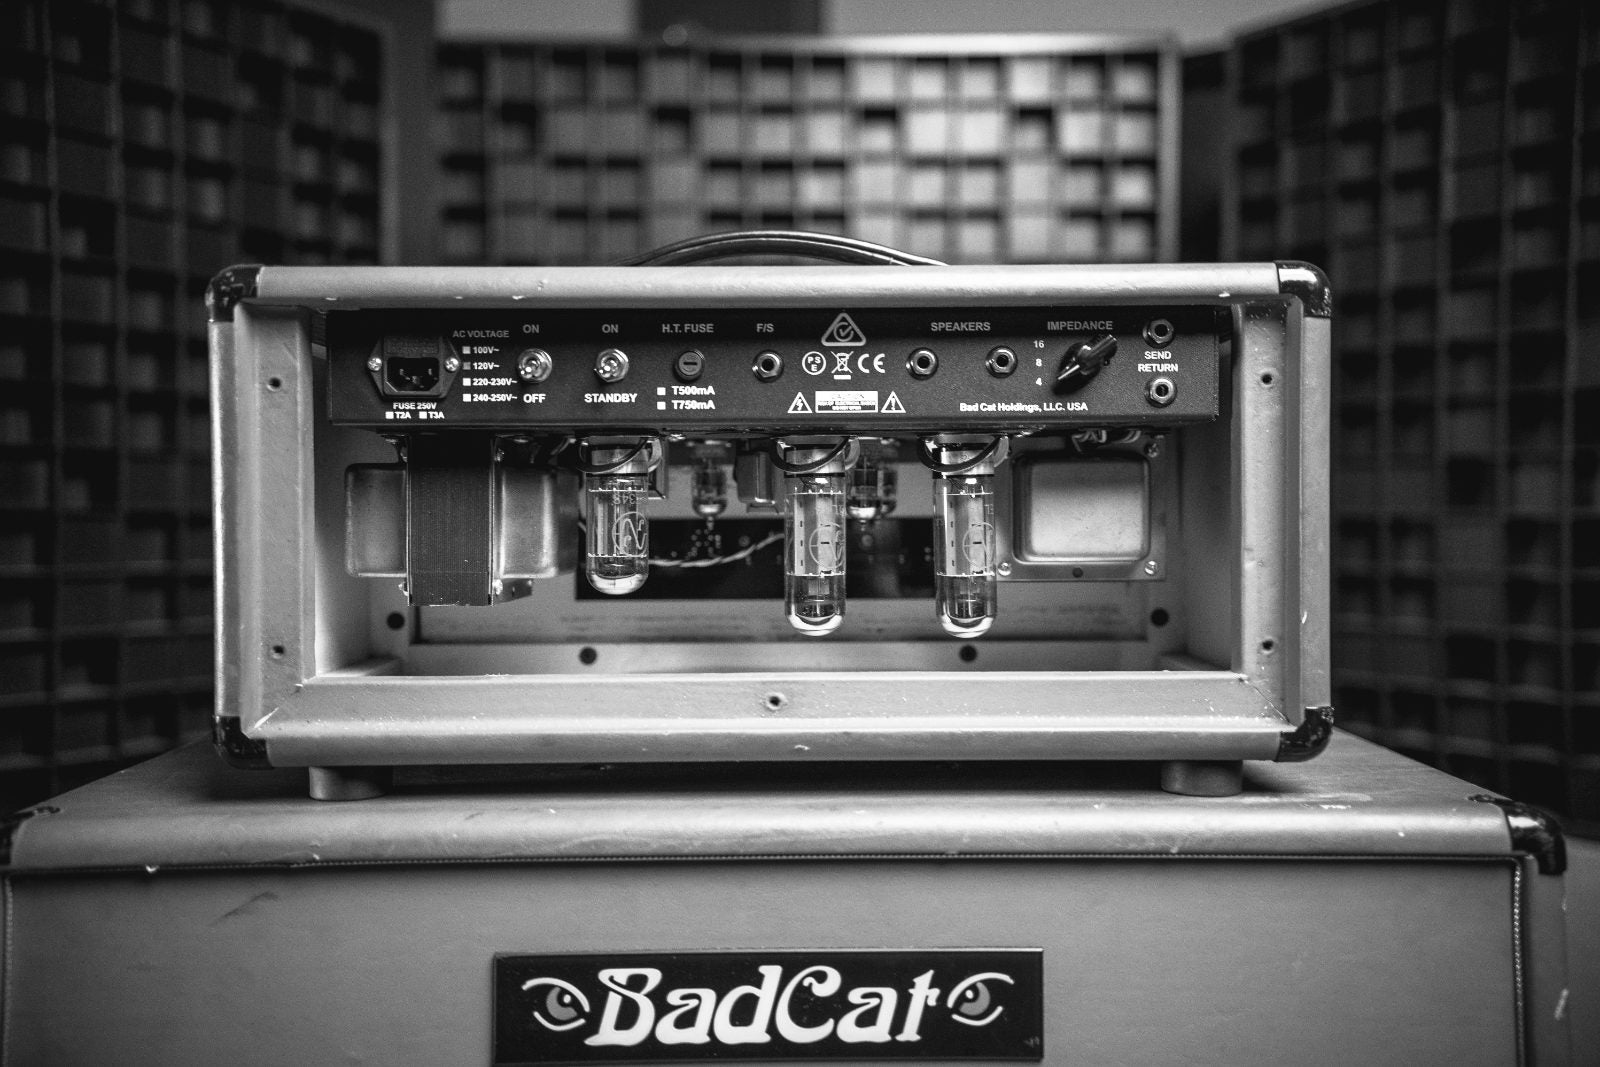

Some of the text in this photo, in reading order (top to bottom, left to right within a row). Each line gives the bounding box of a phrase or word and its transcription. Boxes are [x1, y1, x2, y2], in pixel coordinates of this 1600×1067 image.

[522, 323, 540, 334] ON
[601, 323, 619, 334] ON
[661, 323, 714, 333] H.T. FUSE
[756, 323, 775, 333] F/S
[930, 321, 991, 332] SPEAKERS
[1047, 320, 1113, 331] IMPEDANCE
[452, 329, 510, 338] AC VOLTAGE
[1033, 339, 1045, 349] 16
[1144, 350, 1172, 360] SEND
[858, 354, 885, 373] CE
[1137, 363, 1179, 373] RETURN
[671, 385, 716, 396] T500mA
[523, 393, 547, 404] OFF
[584, 392, 638, 404] STANDBY
[393, 402, 436, 410] FUSE 250V
[671, 399, 716, 410] T750mA
[960, 402, 979, 412] Bad
[980, 402, 996, 412] Cat
[998, 402, 1042, 414] Holdings,
[1066, 401, 1089, 412] USA
[394, 411, 412, 420] T2A
[427, 410, 445, 420] T3A
[584, 965, 940, 1046] BadCat
